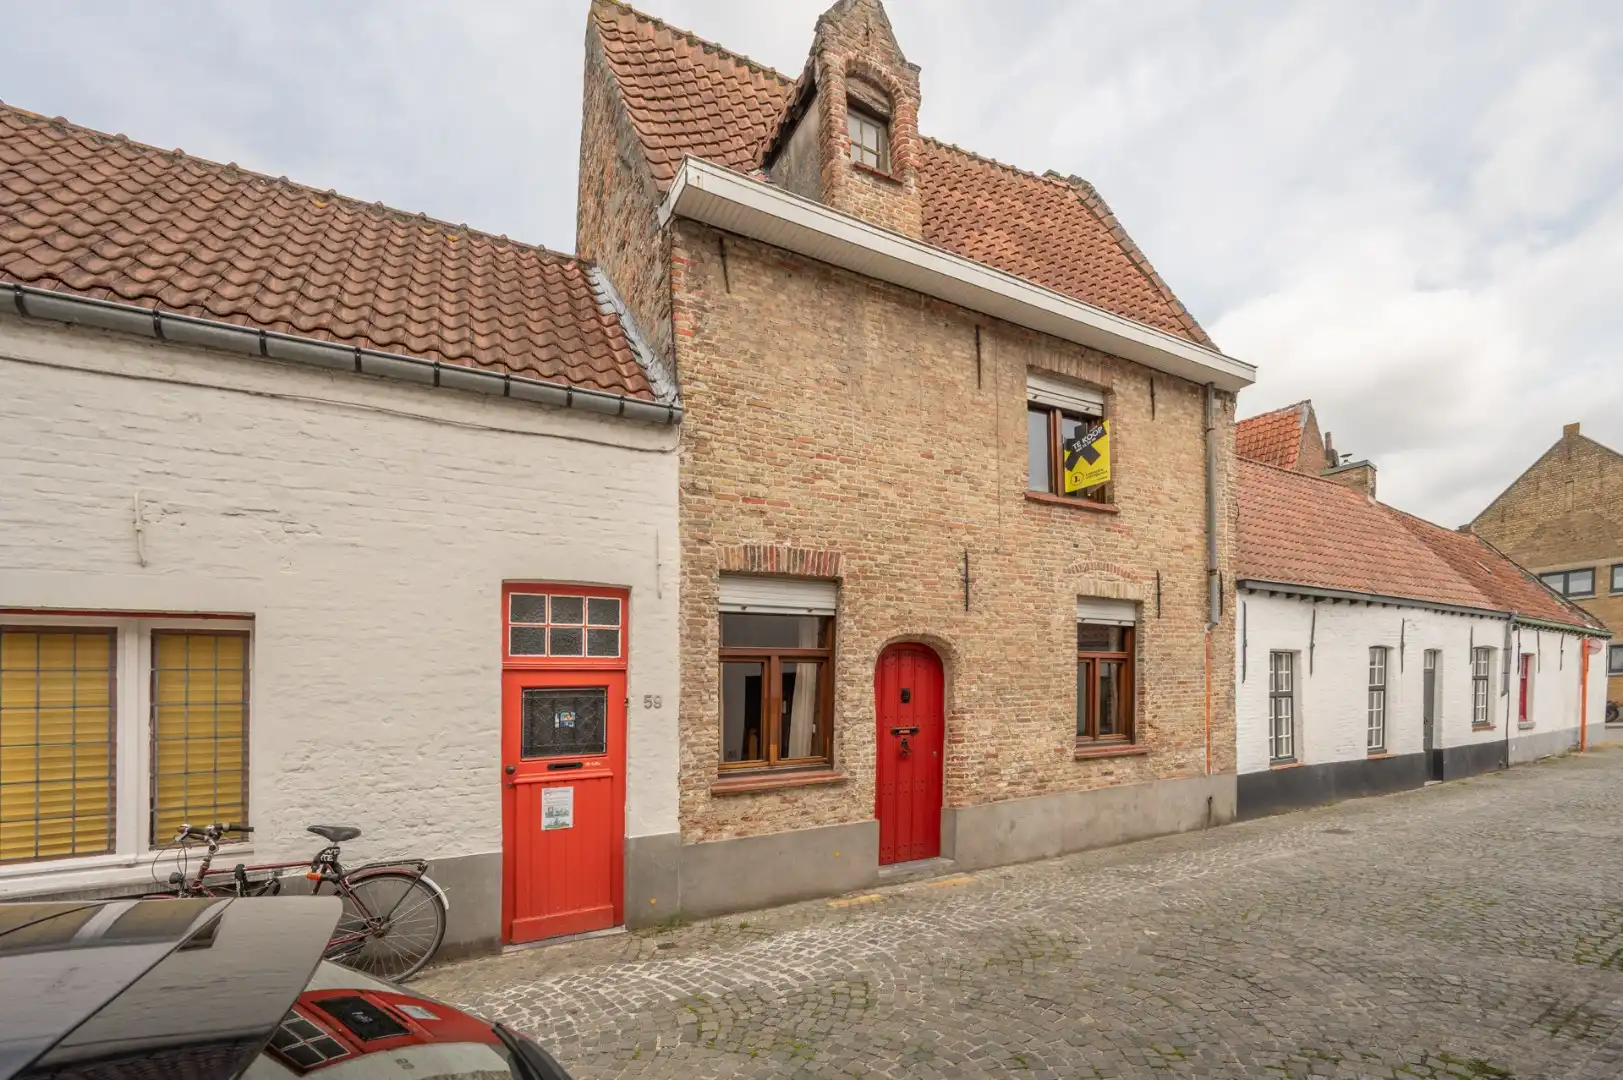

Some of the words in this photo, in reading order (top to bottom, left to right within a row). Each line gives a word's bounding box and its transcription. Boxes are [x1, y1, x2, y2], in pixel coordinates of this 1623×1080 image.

[1072, 440, 1082, 450] TE
[1081, 426, 1103, 444] KOOP
[643, 694, 663, 710] 59
